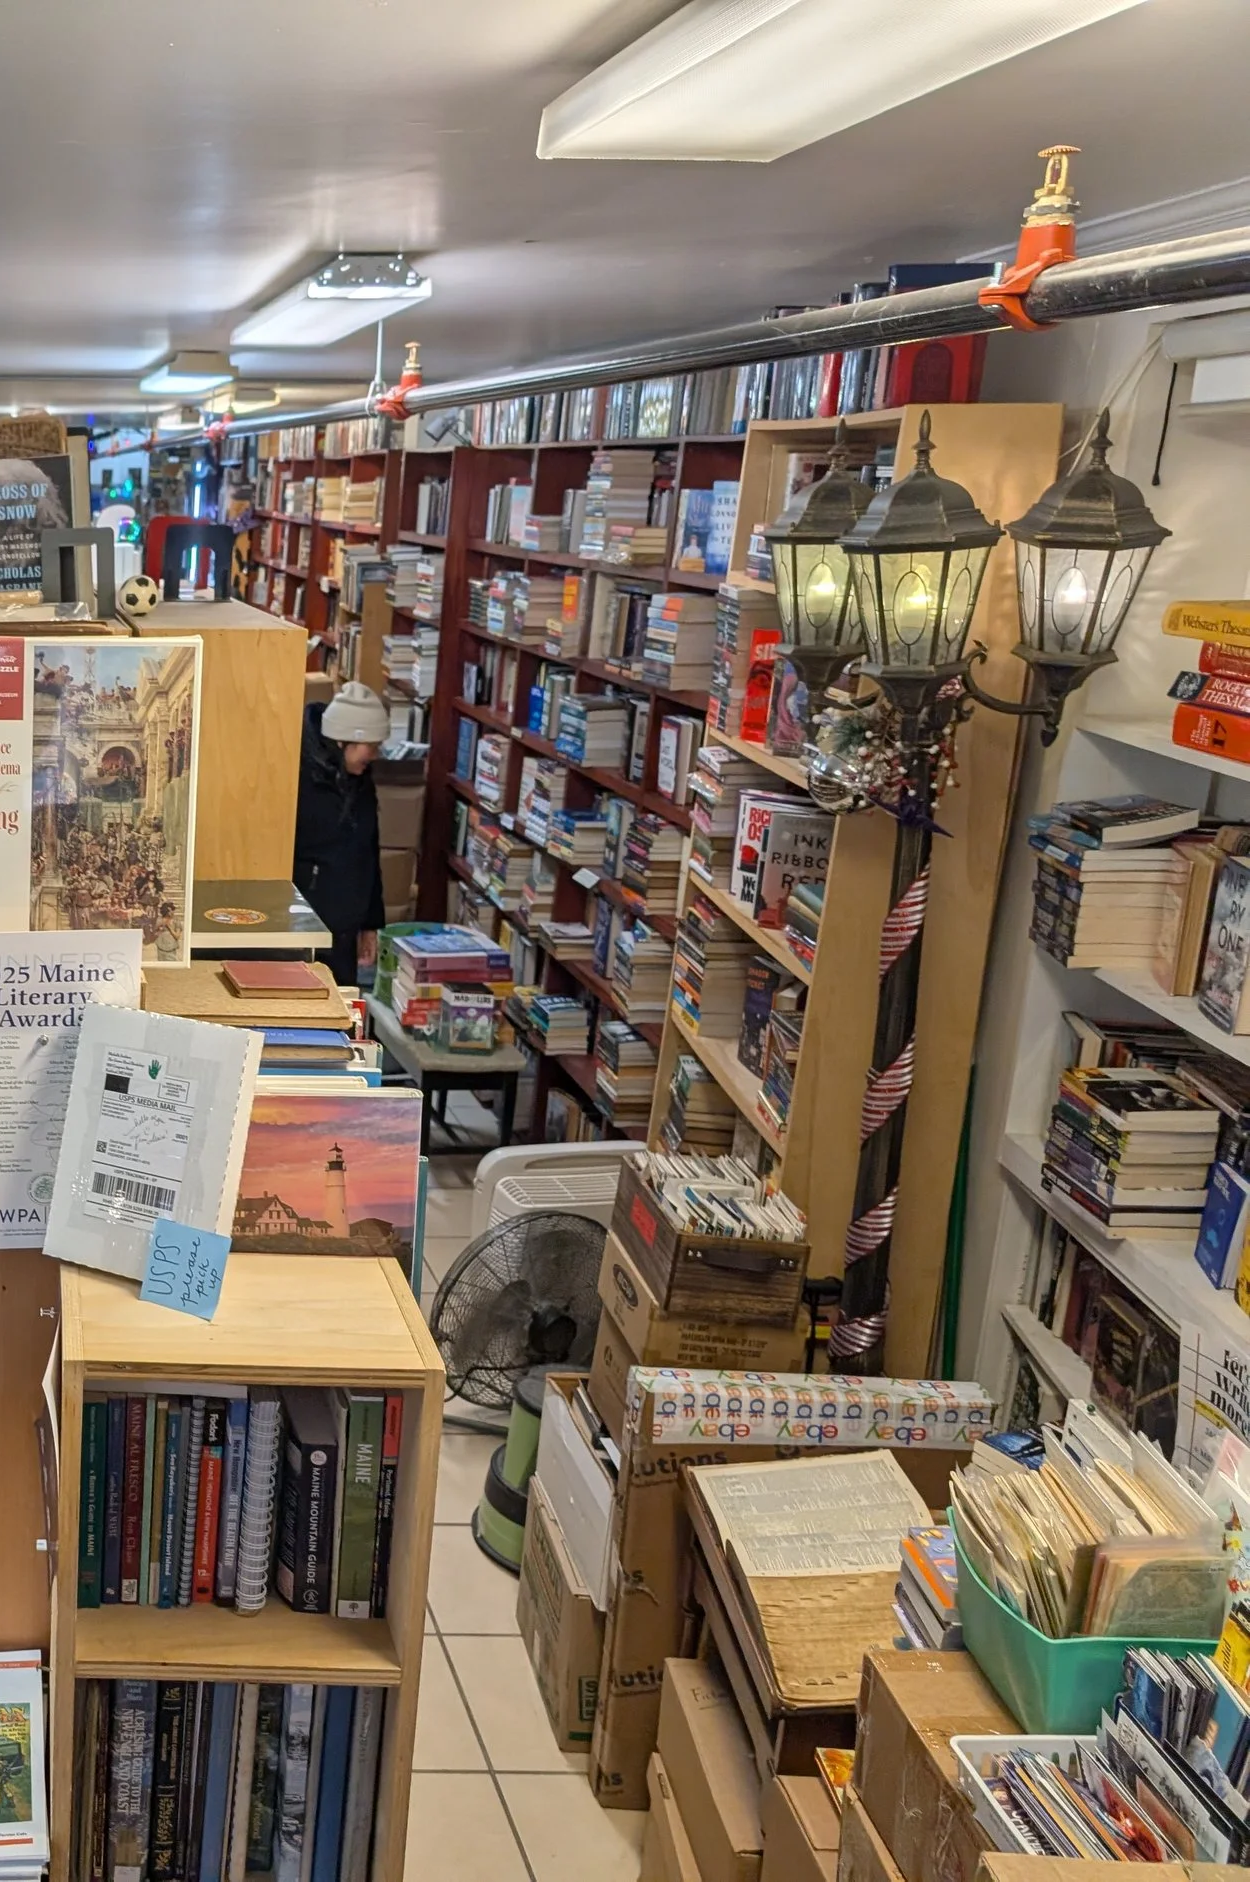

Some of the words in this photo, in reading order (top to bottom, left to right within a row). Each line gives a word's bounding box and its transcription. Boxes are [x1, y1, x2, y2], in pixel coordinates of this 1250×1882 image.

[32, 483, 48, 497] OF
[794, 834, 827, 850] INK
[1230, 900, 1246, 924] BY
[39, 964, 114, 983] Maine
[119, 1094, 136, 1103] USPS
[137, 1098, 158, 1108] MEDIA
[160, 1102, 176, 1112] MAIL
[148, 1235, 181, 1295] USPS
[181, 1236, 201, 1307] please
[196, 1258, 210, 1297] pick
[209, 1268, 222, 1289] up
[130, 1404, 141, 1439] MAINE
[208, 1414, 218, 1442] Fodor's
[689, 1419, 750, 1442] ebay
[777, 1419, 838, 1443] ebay
[865, 1421, 926, 1445] ebay
[129, 1444, 140, 1457] AL
[232, 1439, 241, 1454] New
[355, 1444, 373, 1484] MAINE
[634, 1451, 727, 1477] utions
[129, 1460, 140, 1502] FRESCO
[310, 1468, 320, 1498] MAINE
[384, 1469, 393, 1497] Portland,
[228, 1494, 238, 1508] OFF
[383, 1499, 391, 1518] Maine
[126, 1516, 136, 1534] Ron
[166, 1514, 174, 1534] Mount
[225, 1522, 236, 1547] BEATEN
[307, 1500, 318, 1552] MOUNTAIN
[87, 1534, 95, 1556] MAINE
[224, 1548, 234, 1566] PATH
[164, 1556, 172, 1575] Island
[306, 1554, 317, 1584] GUIDE
[120, 1708, 132, 1732] NEW
[132, 1717, 145, 1757] CRUISING
[119, 1733, 131, 1781] ENGLAND
[131, 1757, 143, 1784] GUIDE
[117, 1782, 130, 1815] COAST
[131, 1785, 141, 1796] TO
[129, 1798, 142, 1815] THE
